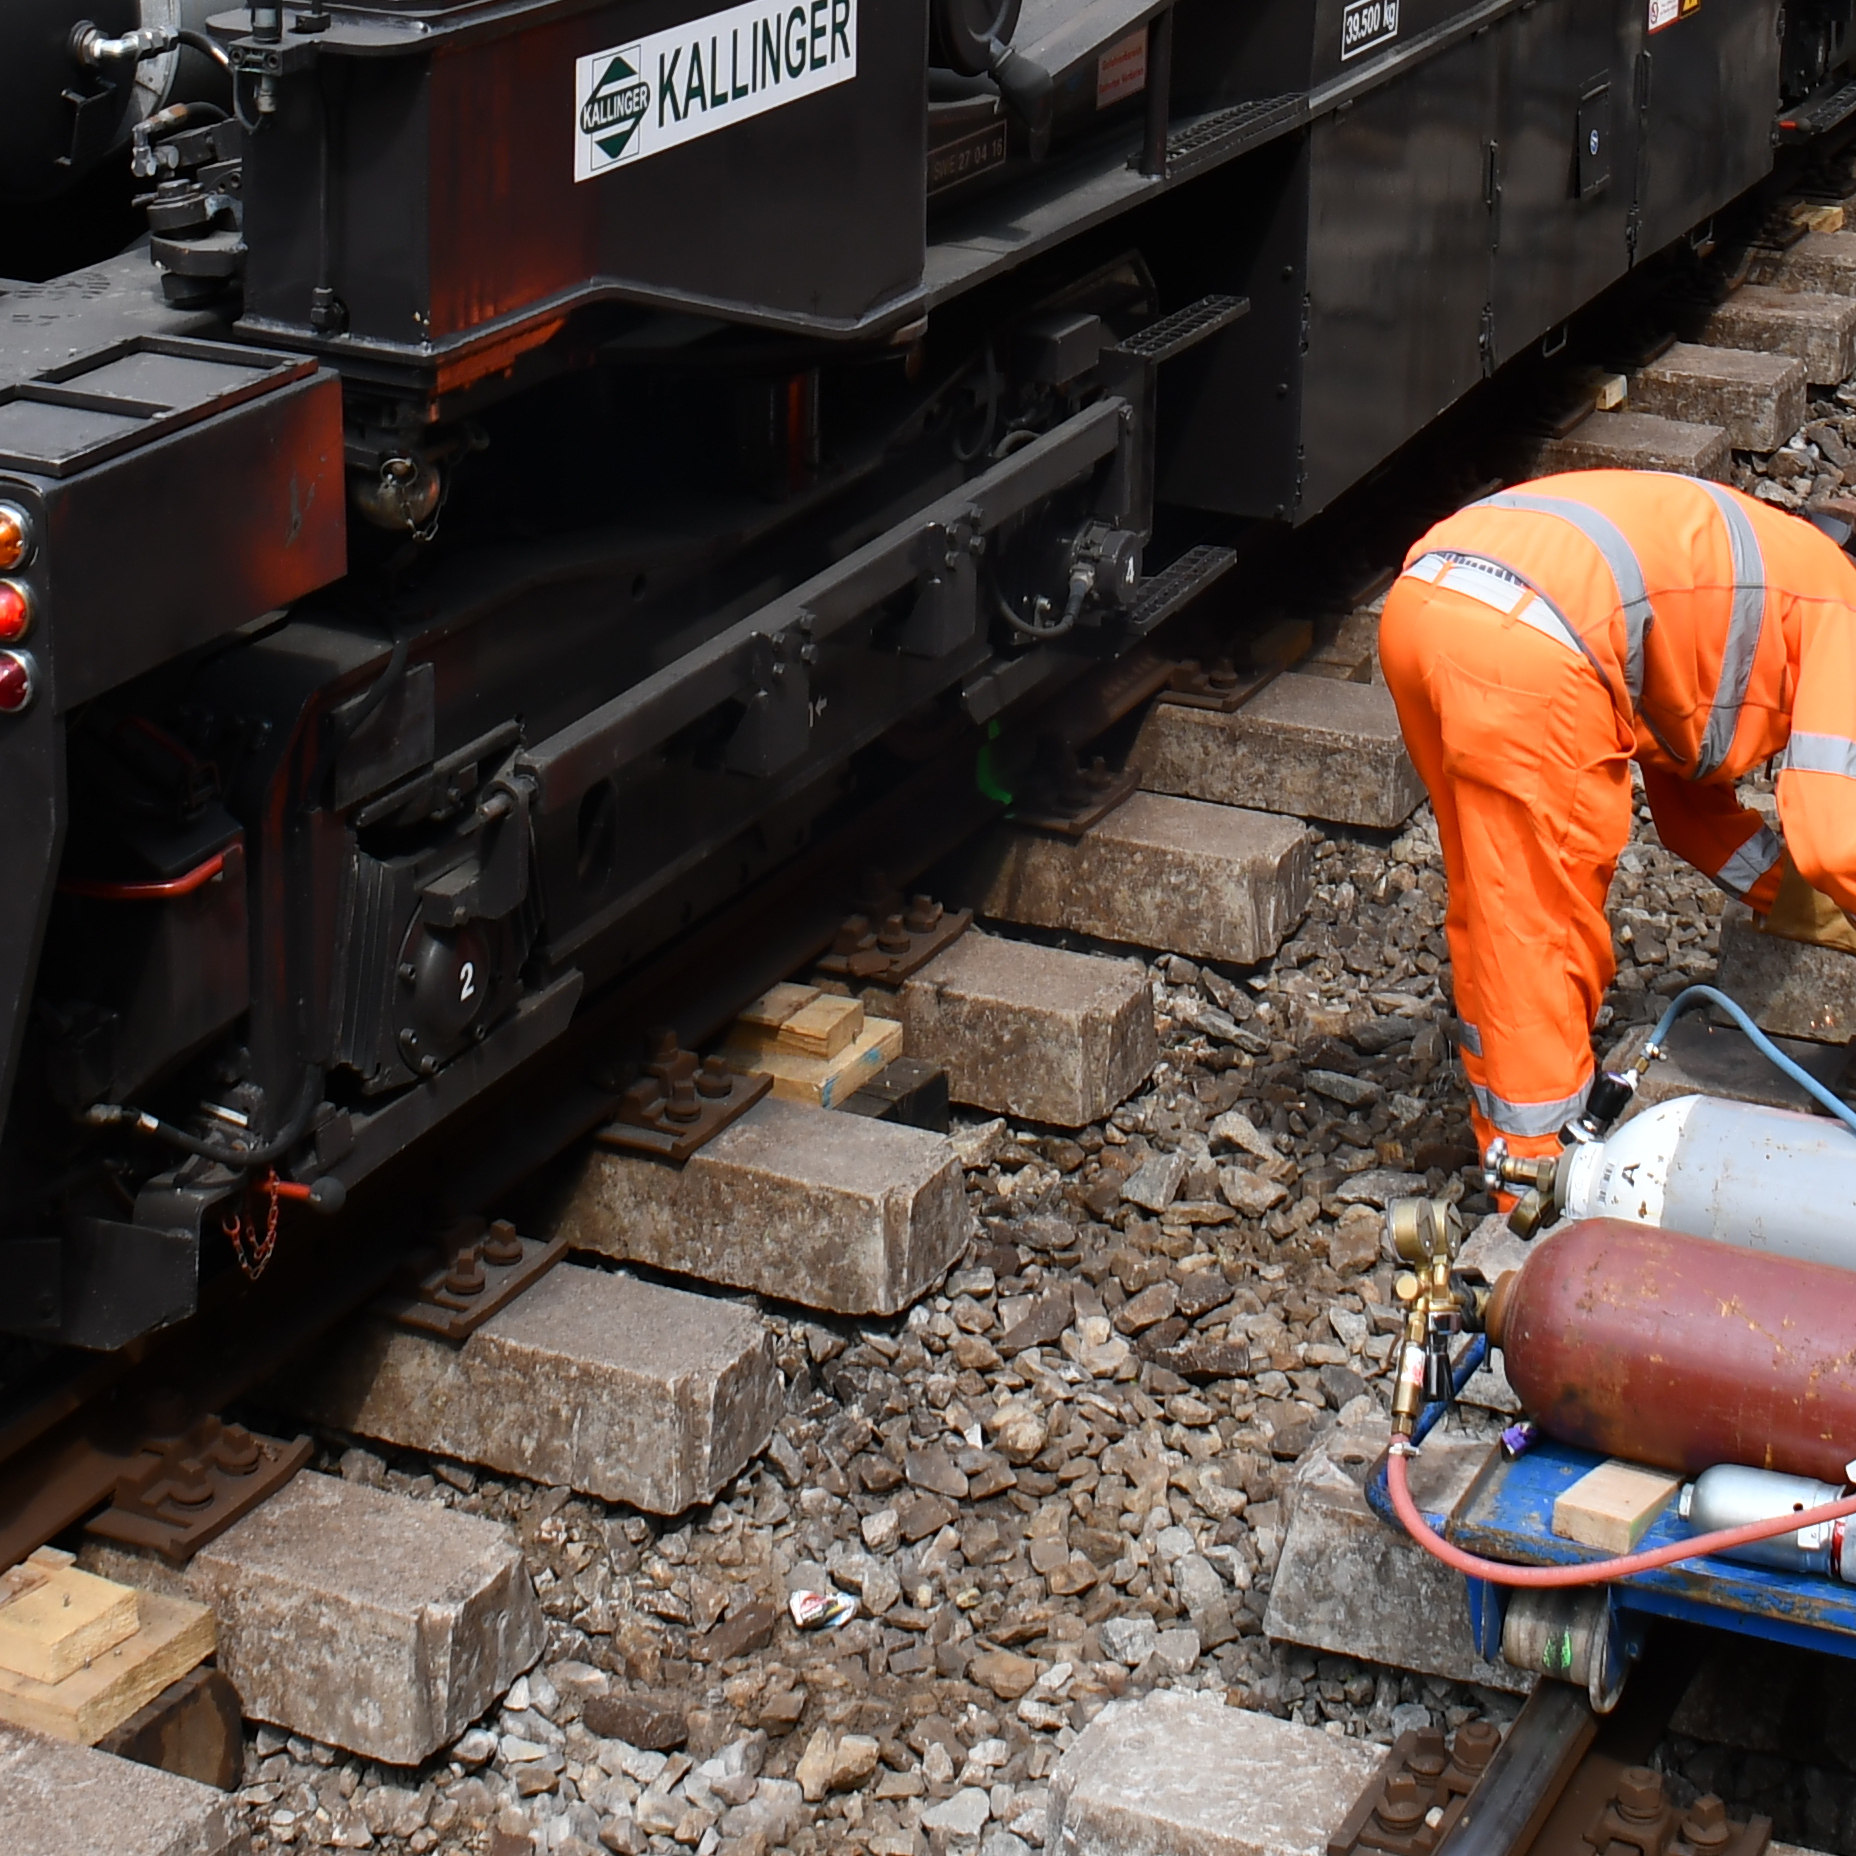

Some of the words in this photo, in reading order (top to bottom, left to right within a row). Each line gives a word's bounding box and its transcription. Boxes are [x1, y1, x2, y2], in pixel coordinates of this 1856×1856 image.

[1346, 2, 1381, 45] 39.500
[582, 86, 648, 130] KALLINGER
[459, 961, 475, 1002] 2
